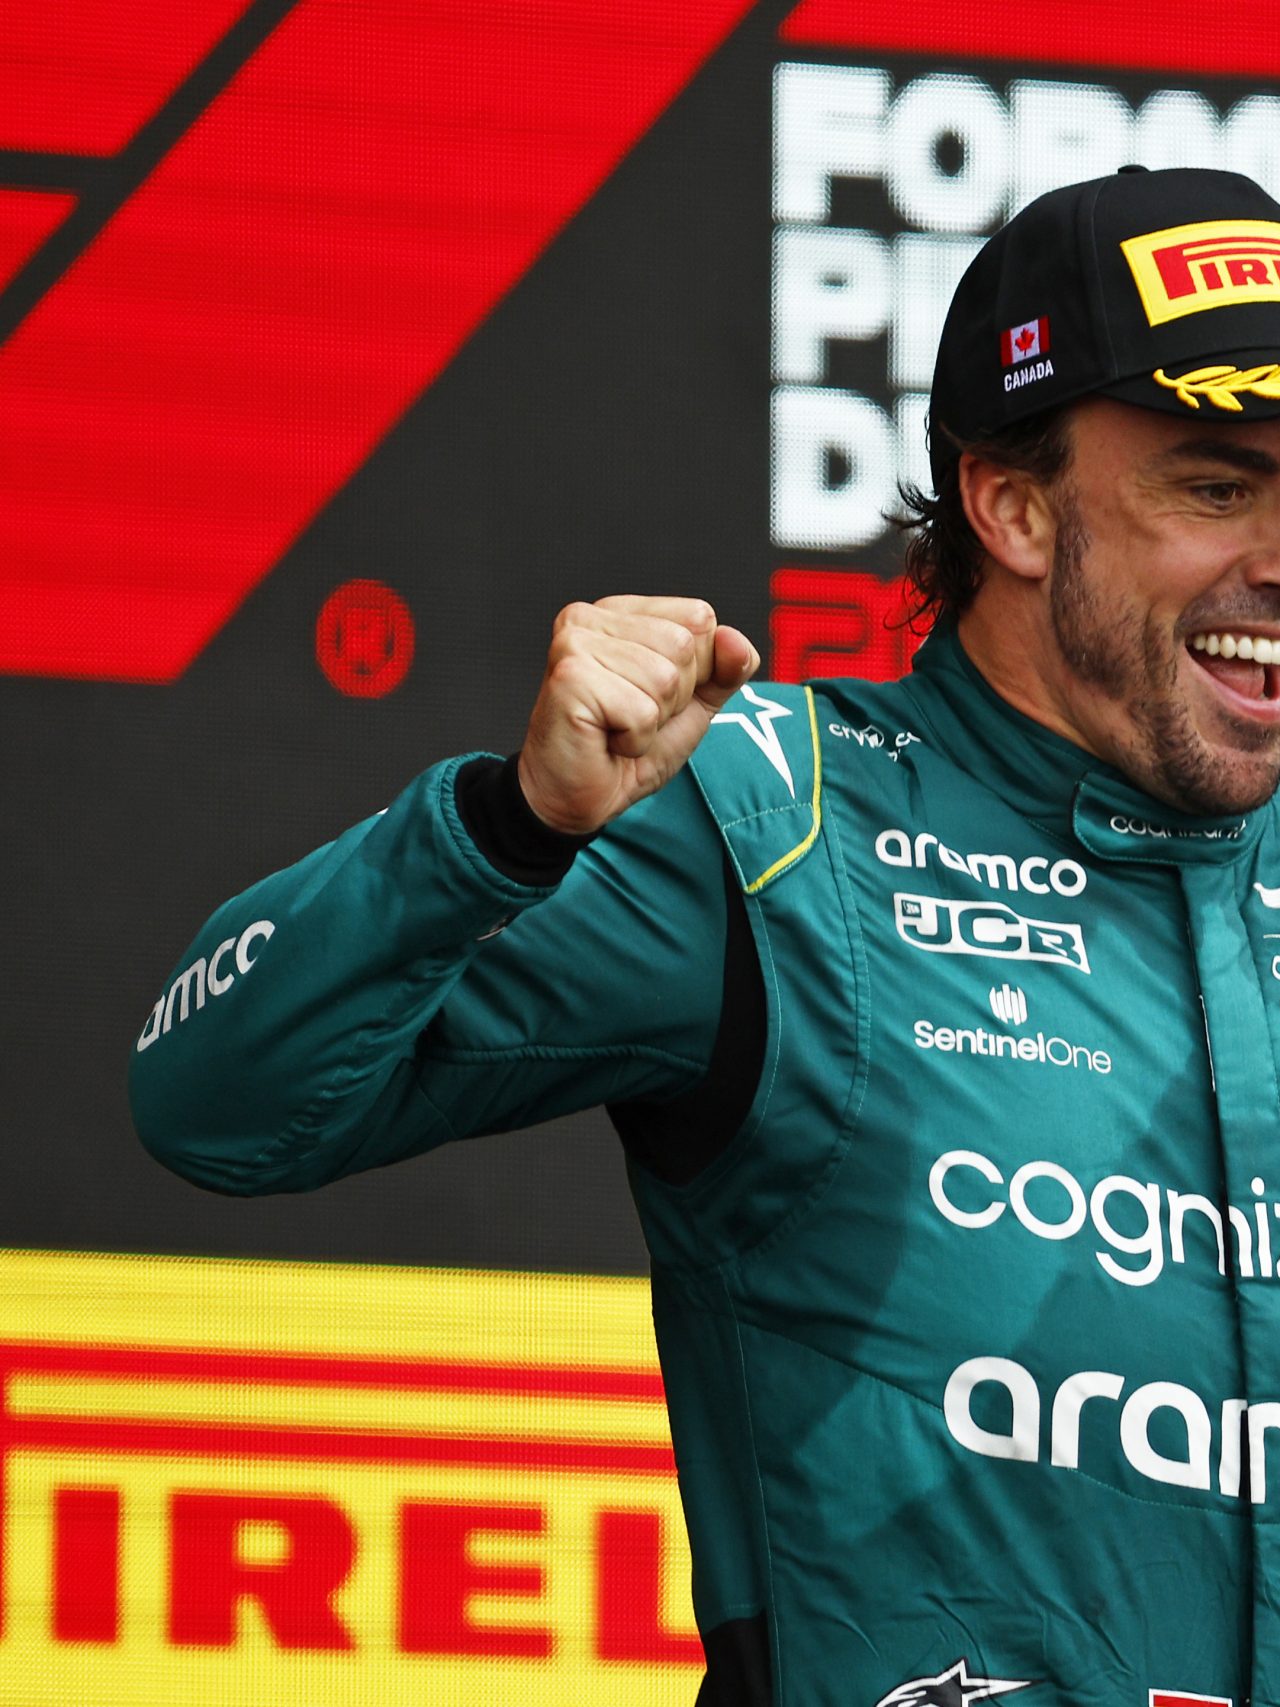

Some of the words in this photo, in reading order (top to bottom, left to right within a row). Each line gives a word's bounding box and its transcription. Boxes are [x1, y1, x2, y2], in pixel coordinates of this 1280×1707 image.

[1004, 359, 1054, 392] CANADA
[902, 903, 1083, 966] JCB
[913, 1020, 1112, 1074] SentinelOne
